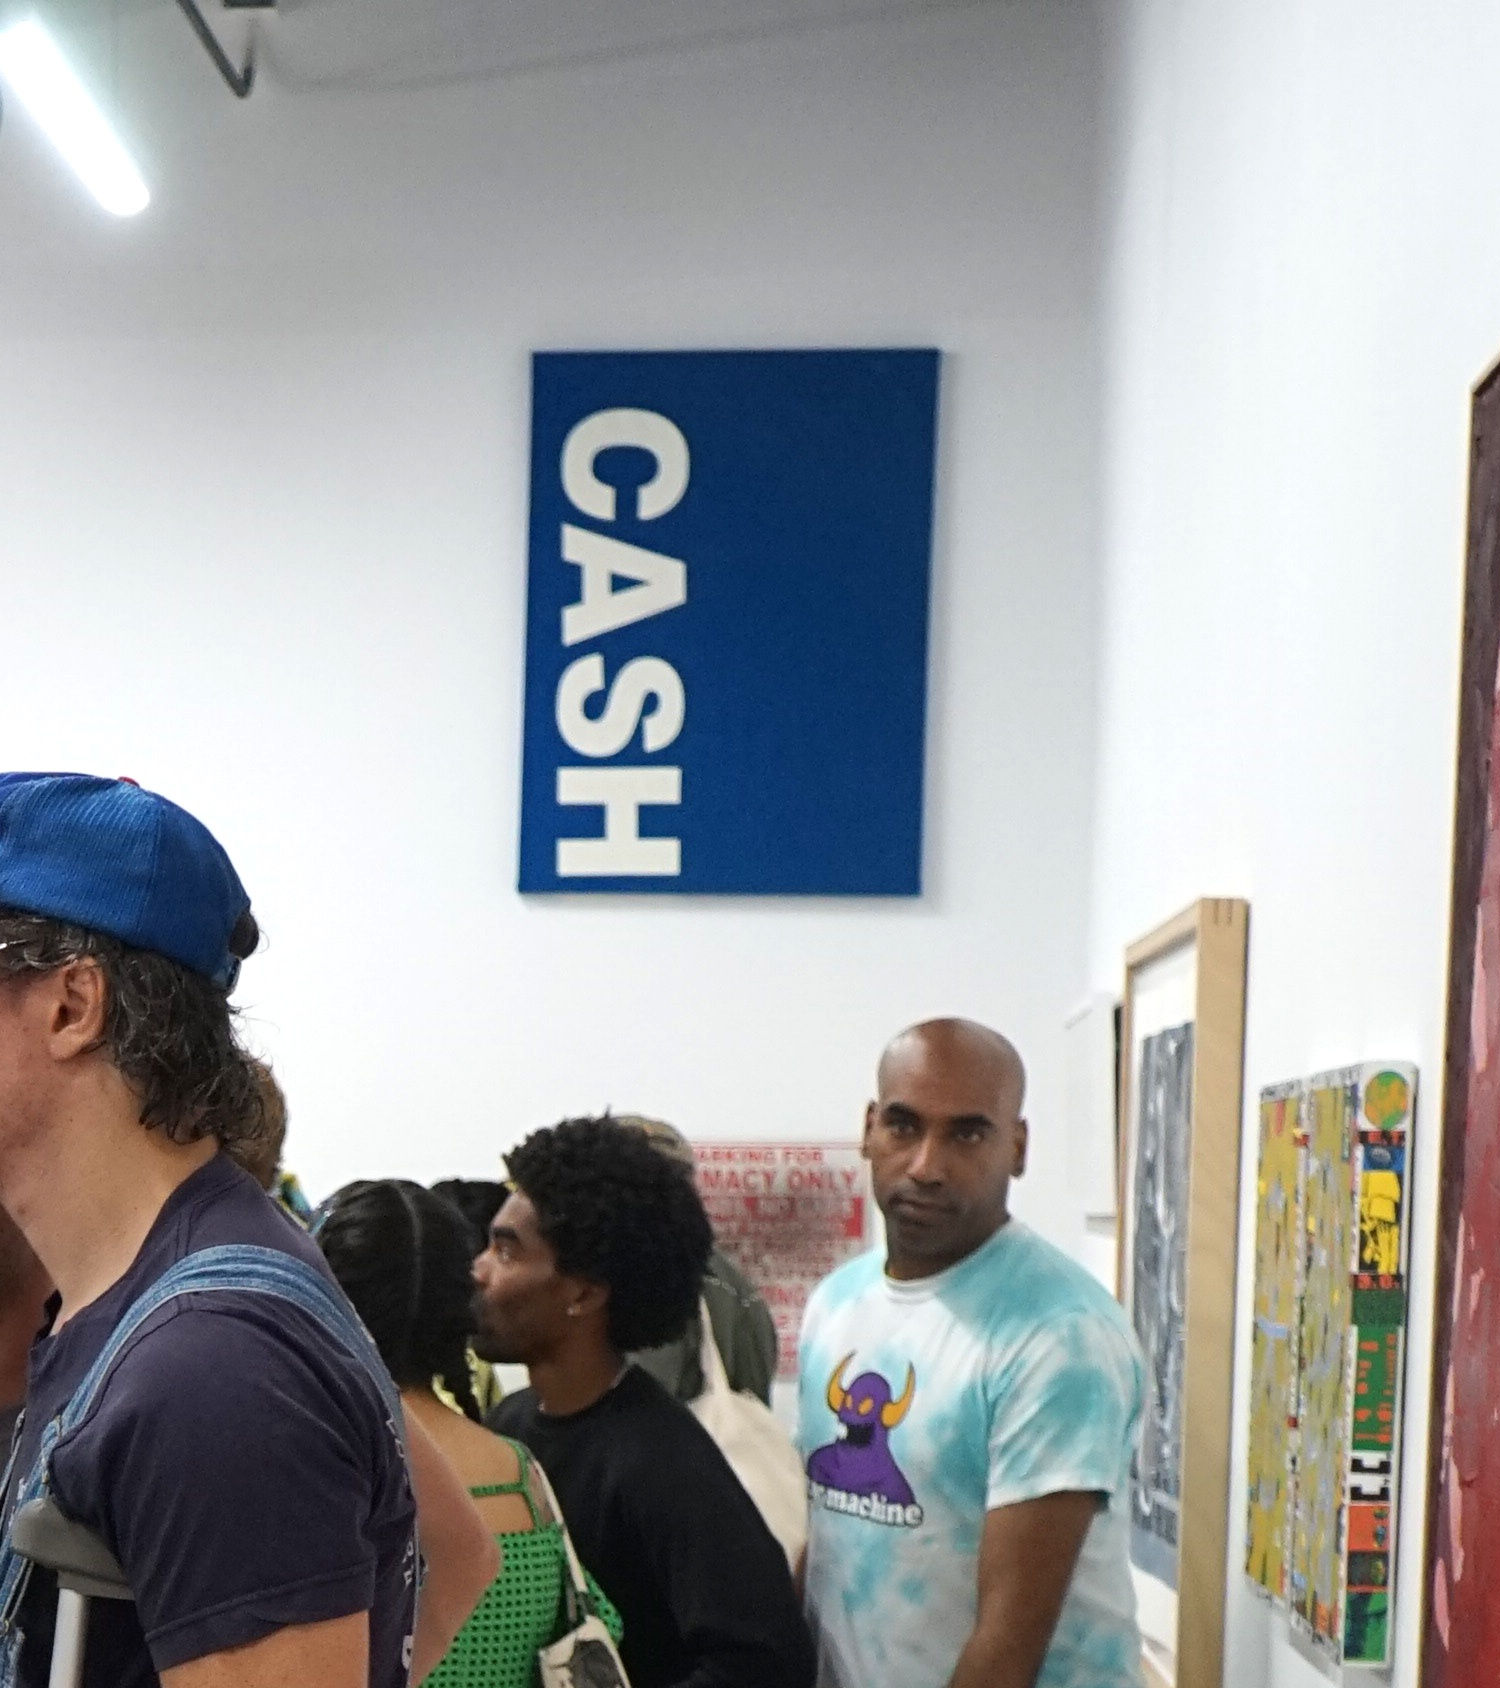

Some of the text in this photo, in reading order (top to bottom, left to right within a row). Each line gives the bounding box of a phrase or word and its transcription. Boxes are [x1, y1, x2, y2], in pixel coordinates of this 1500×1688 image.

[555, 406, 691, 878] CASH
[692, 1147, 776, 1162] ARKING
[701, 1169, 857, 1191] MACY ONLY
[826, 1489, 923, 1527] machine
